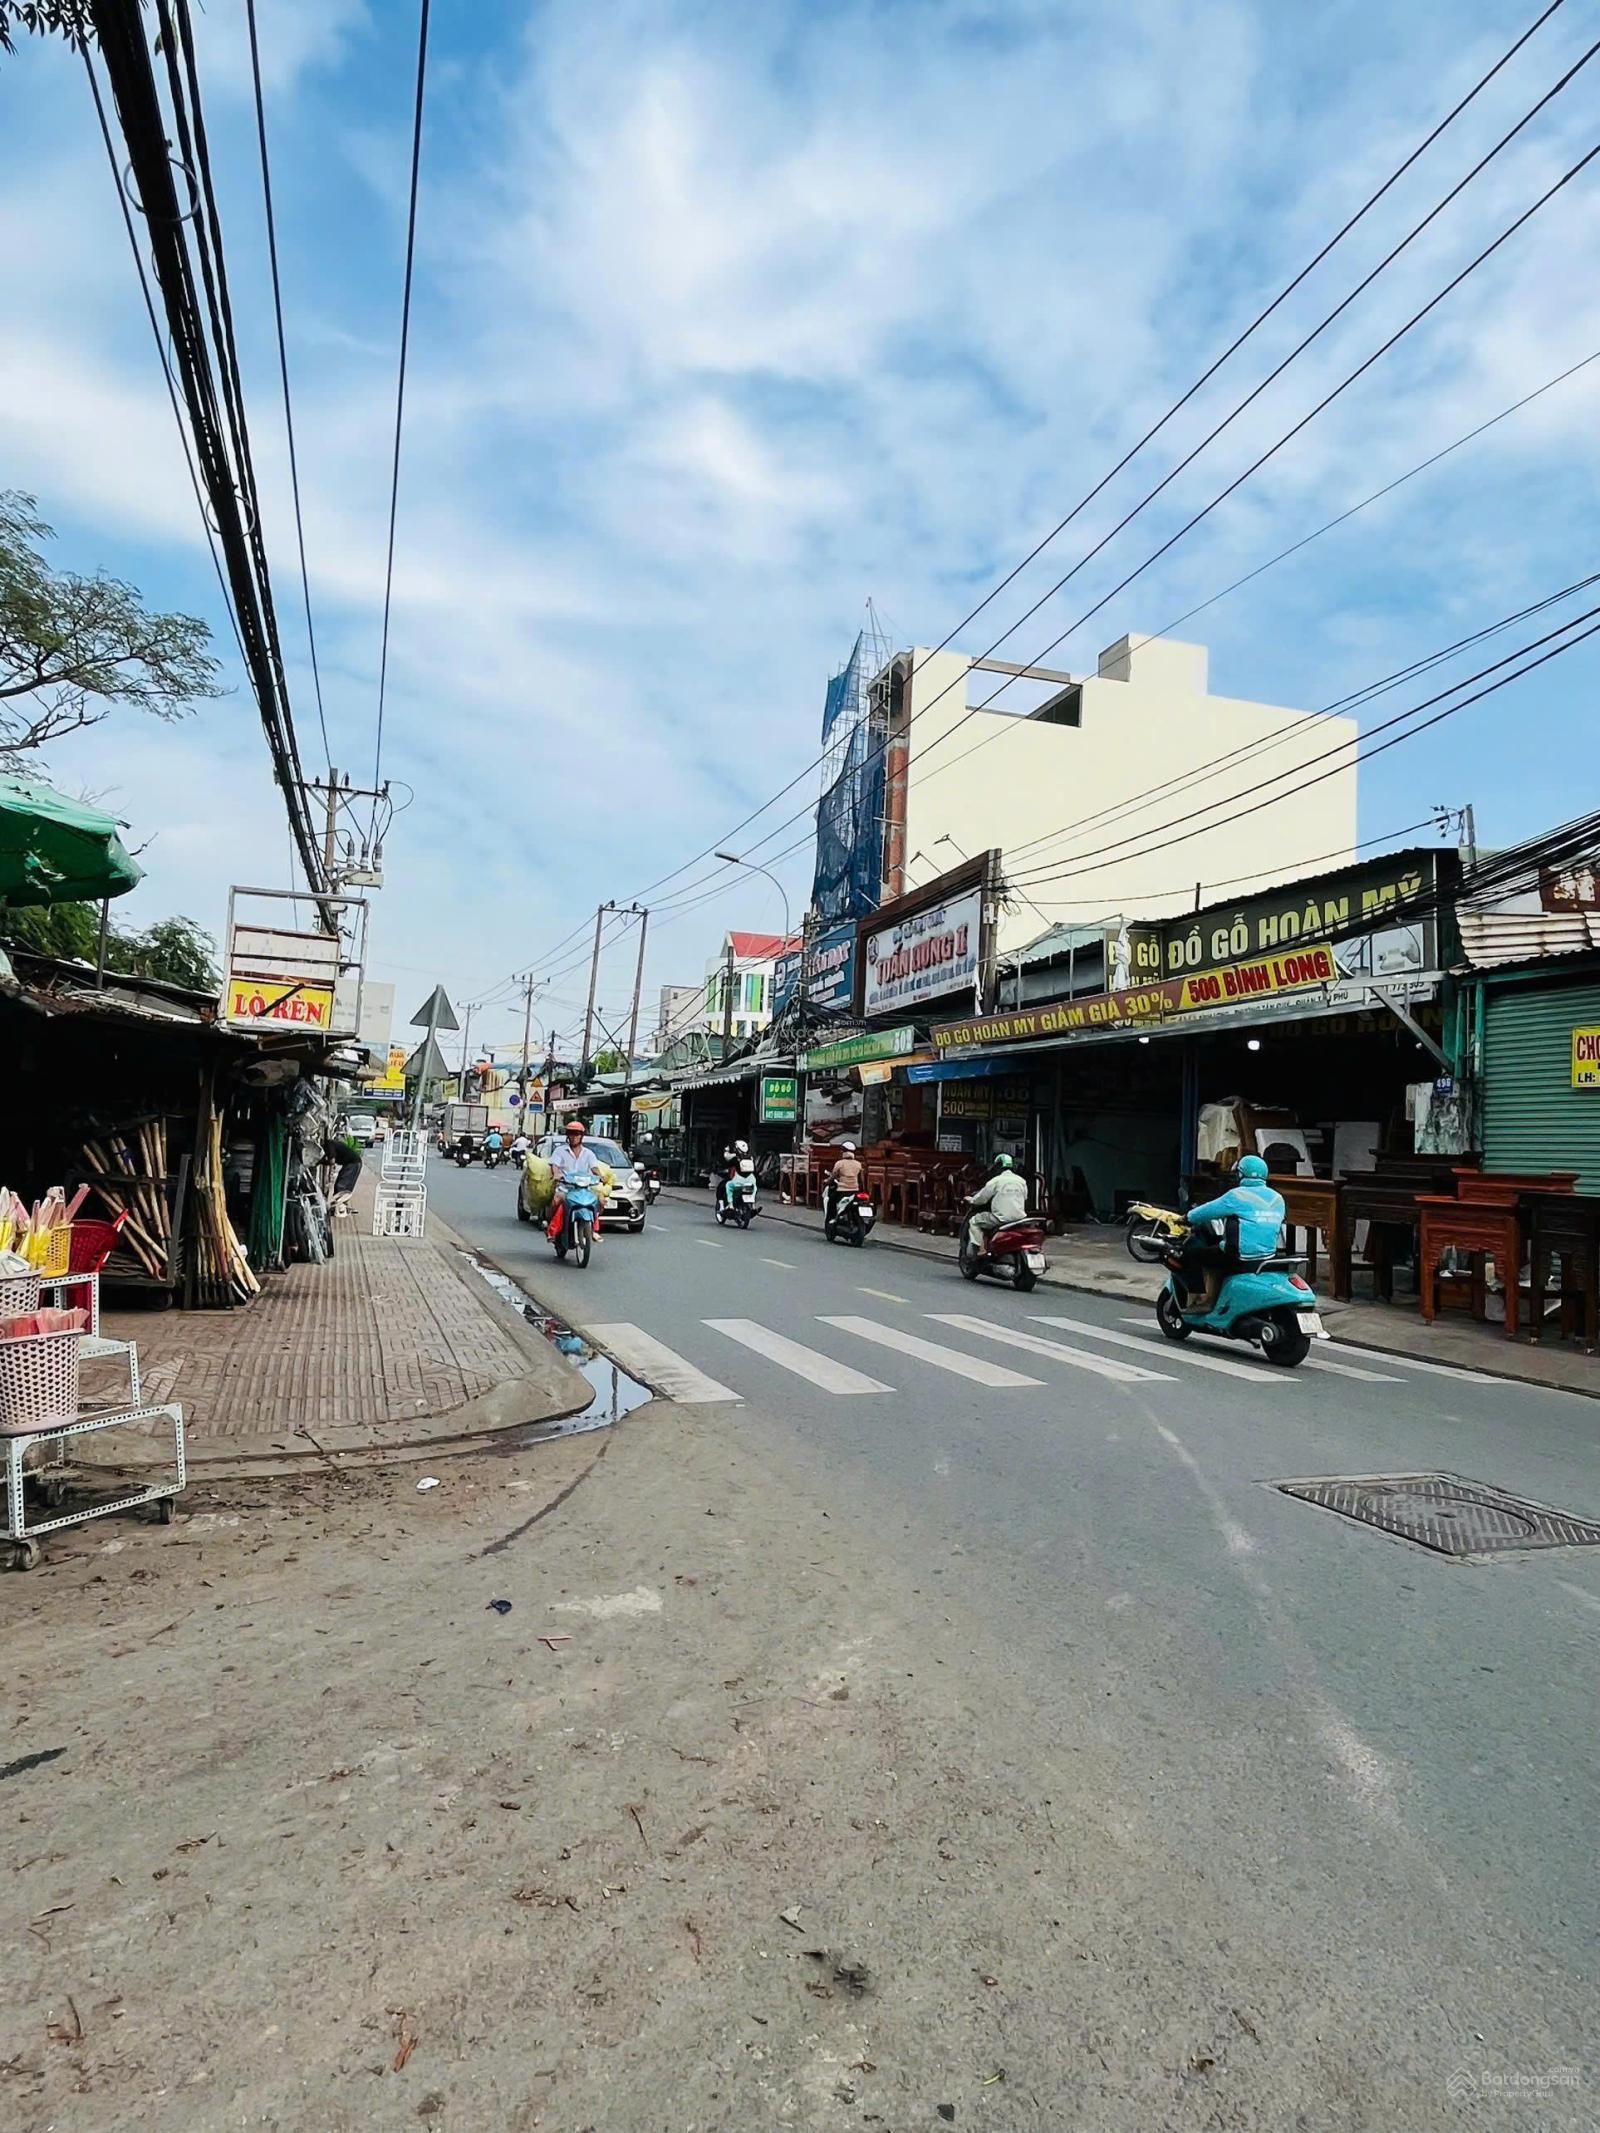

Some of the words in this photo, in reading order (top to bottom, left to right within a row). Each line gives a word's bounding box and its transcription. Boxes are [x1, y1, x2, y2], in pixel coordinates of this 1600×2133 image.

[1168, 926, 1201, 969] ĐỒ
[1212, 912, 1248, 959] GỖ
[1258, 900, 1350, 948] HOÀN
[1362, 871, 1422, 920] MỸ
[1137, 935, 1160, 967] GỖ
[1189, 976, 1221, 1003] 500
[1225, 964, 1270, 997] BÌNH
[1276, 951, 1330, 985] LONG
[234, 989, 267, 1017] LÒ
[272, 995, 326, 1024] RÈN
[1041, 1006, 1085, 1030] GIẢM
[1088, 998, 1121, 1022] GIÁ
[1125, 991, 1173, 1016] 30%
[1577, 1072, 1596, 1083] LH:
[943, 1100, 965, 1115] 500
